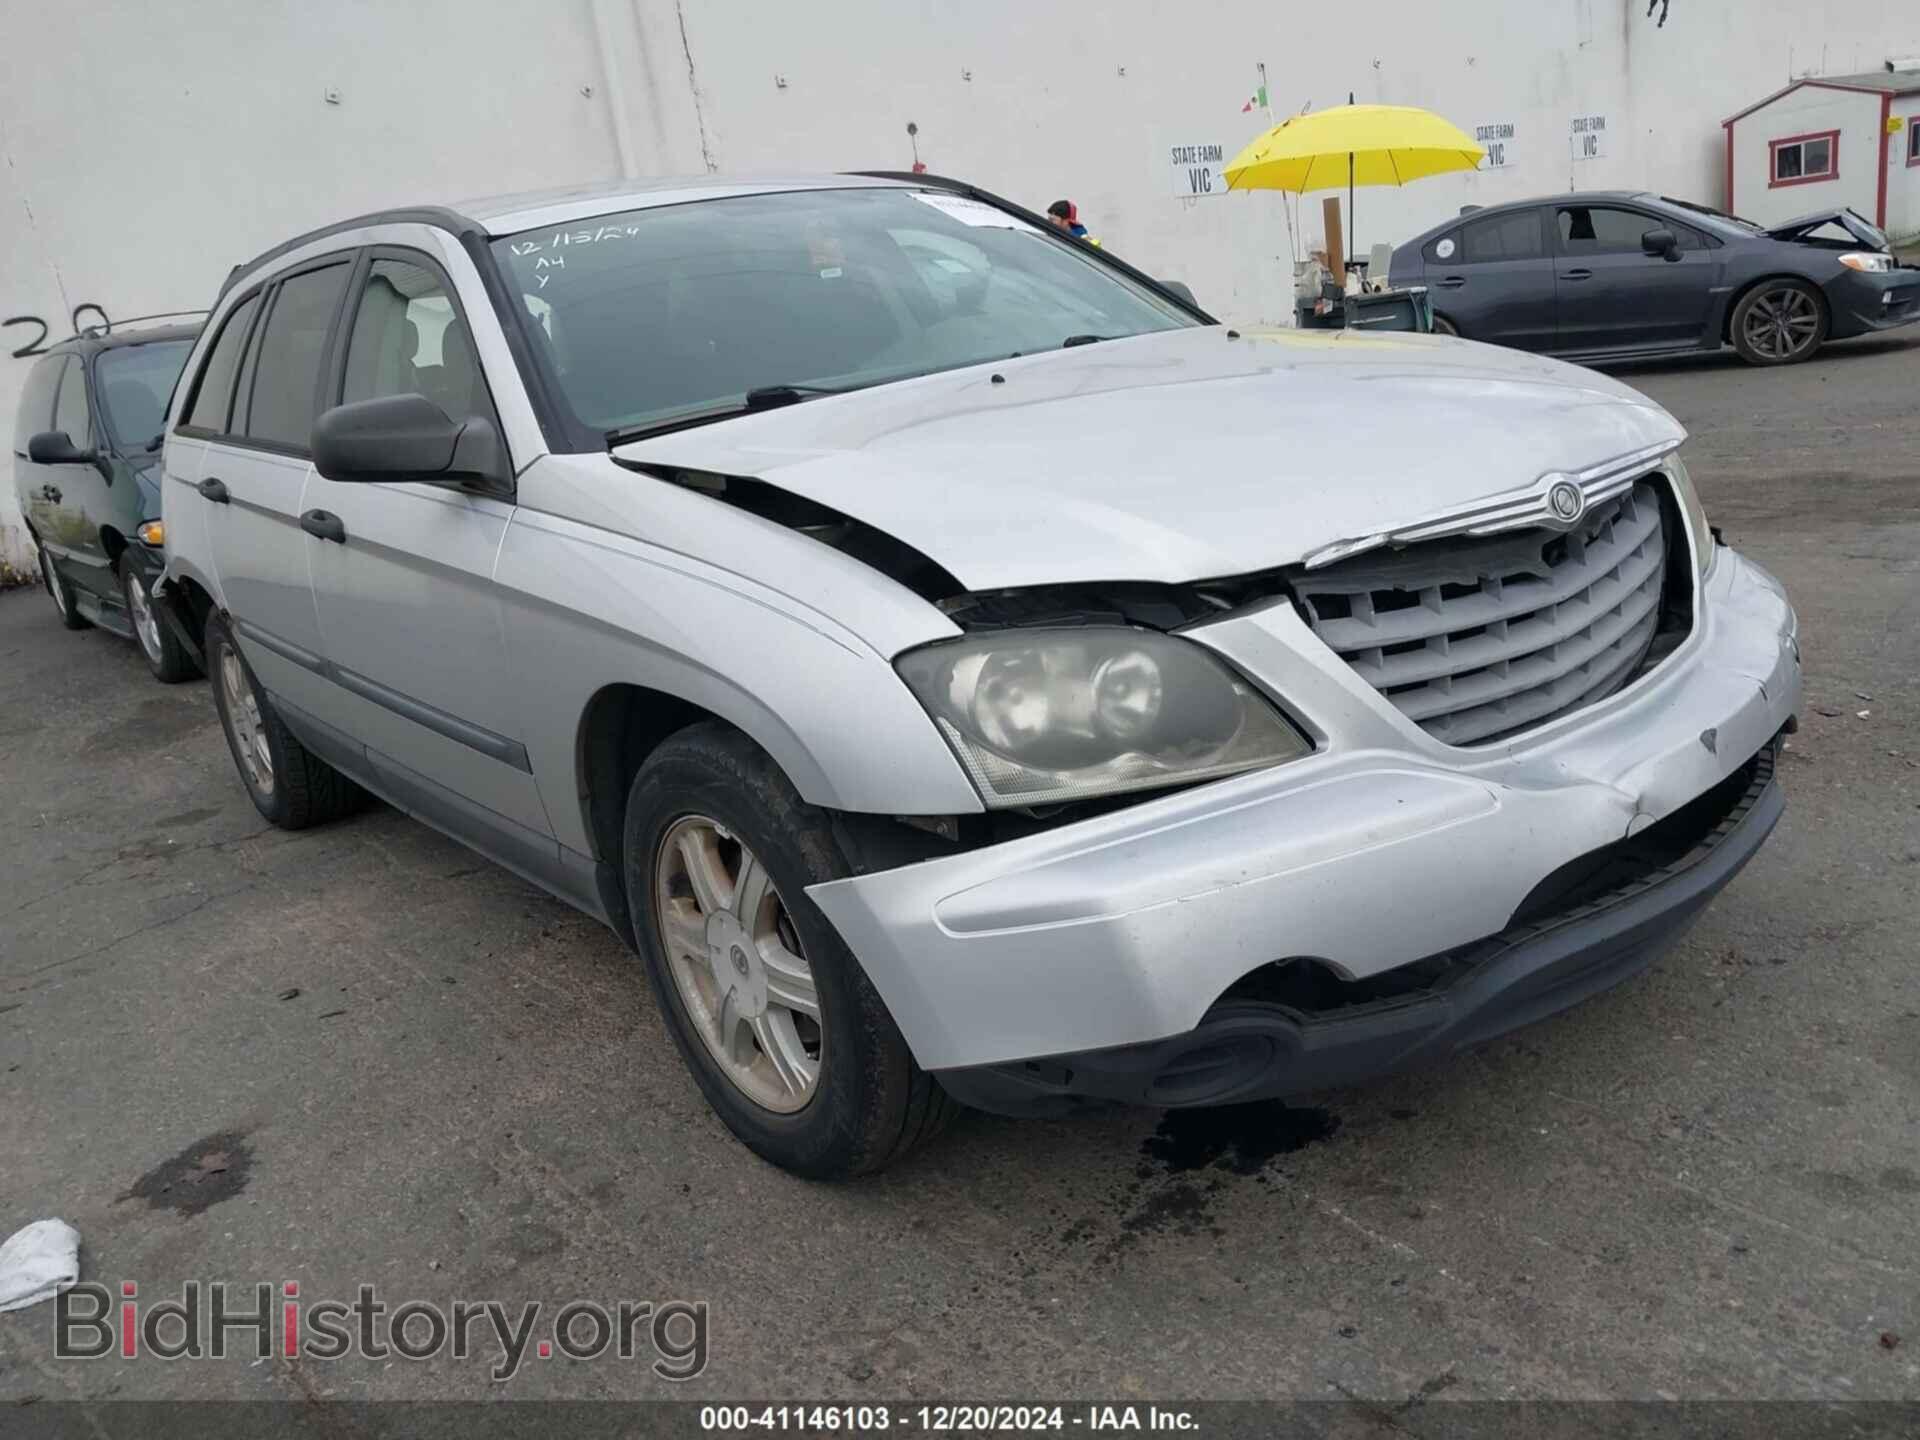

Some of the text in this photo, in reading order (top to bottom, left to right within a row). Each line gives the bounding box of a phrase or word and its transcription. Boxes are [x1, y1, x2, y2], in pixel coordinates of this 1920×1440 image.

[1476, 123, 1515, 141] STATE FARM
[1573, 116, 1606, 133] STATE FARM
[1172, 145, 1223, 165] STATE FARM
[1488, 143, 1505, 166] VIC
[1583, 135, 1597, 156] VIC
[1189, 167, 1212, 193] VIC
